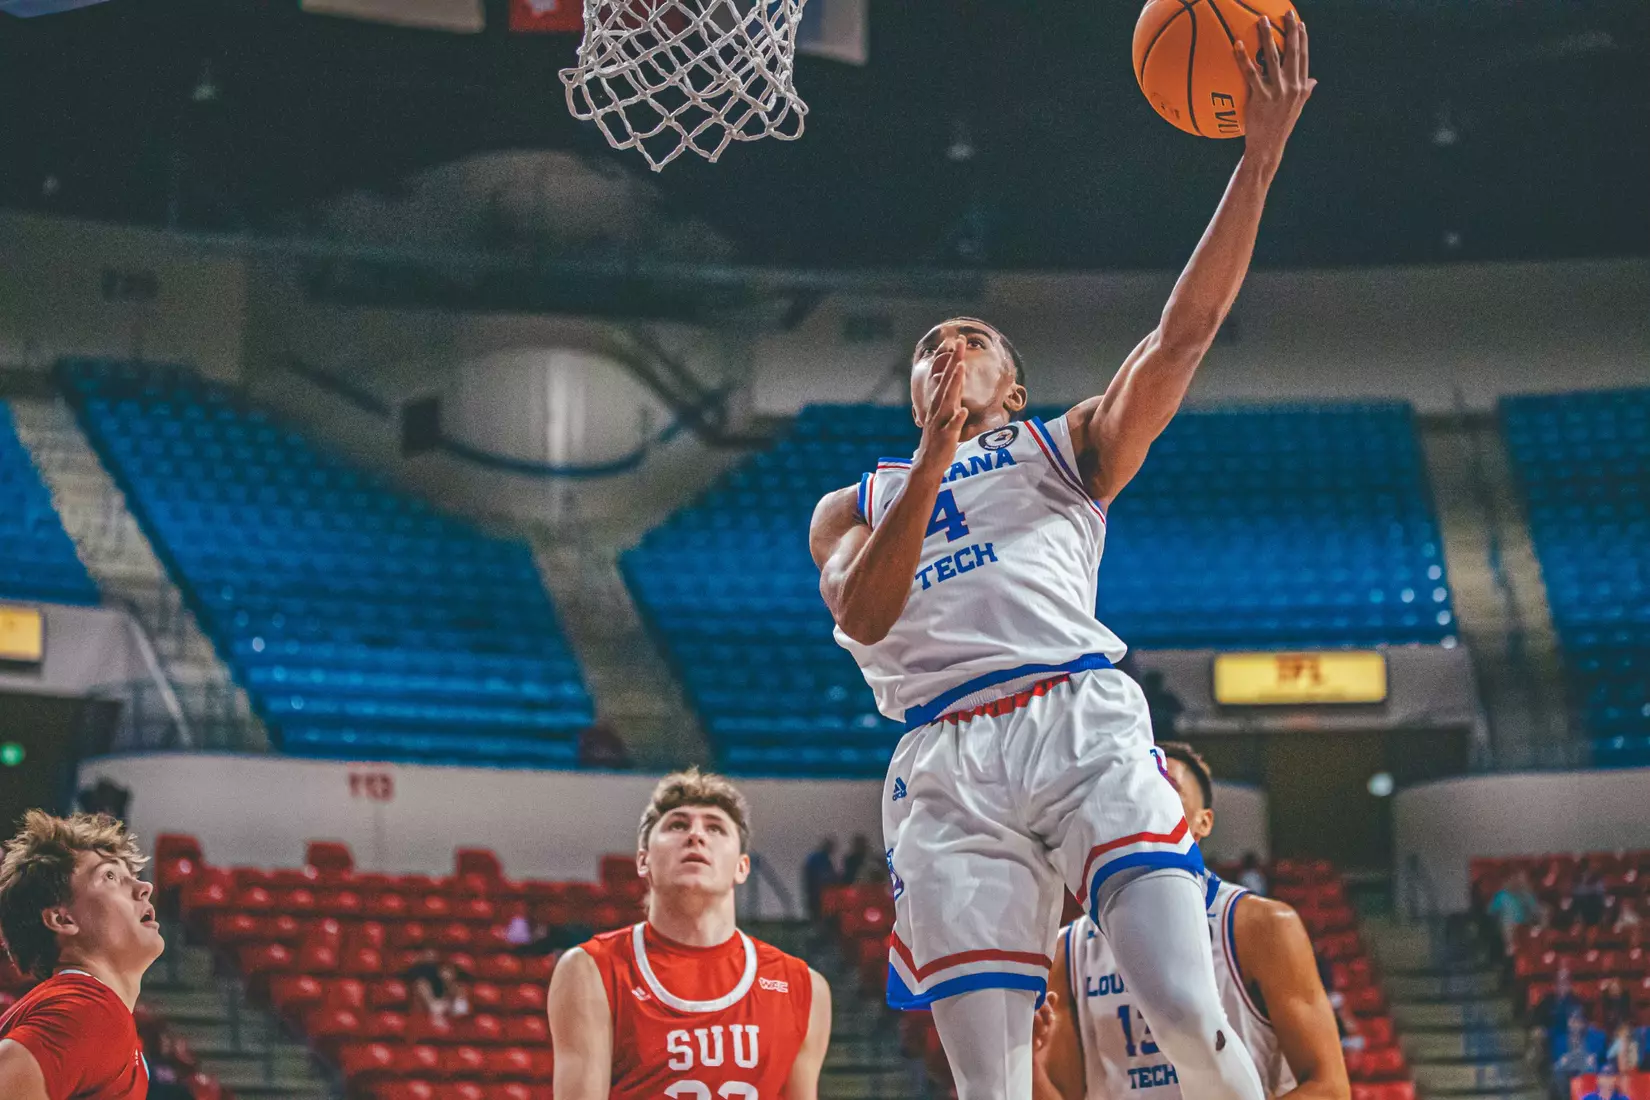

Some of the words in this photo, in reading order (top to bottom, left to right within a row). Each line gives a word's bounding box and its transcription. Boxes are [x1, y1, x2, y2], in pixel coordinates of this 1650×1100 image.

[941, 449, 1017, 483] ANA
[925, 488, 970, 543] 4
[915, 542, 998, 590] TECH
[1086, 973, 1128, 997] LOU
[666, 1024, 760, 1071] SUU
[1126, 1063, 1179, 1089] TECH
